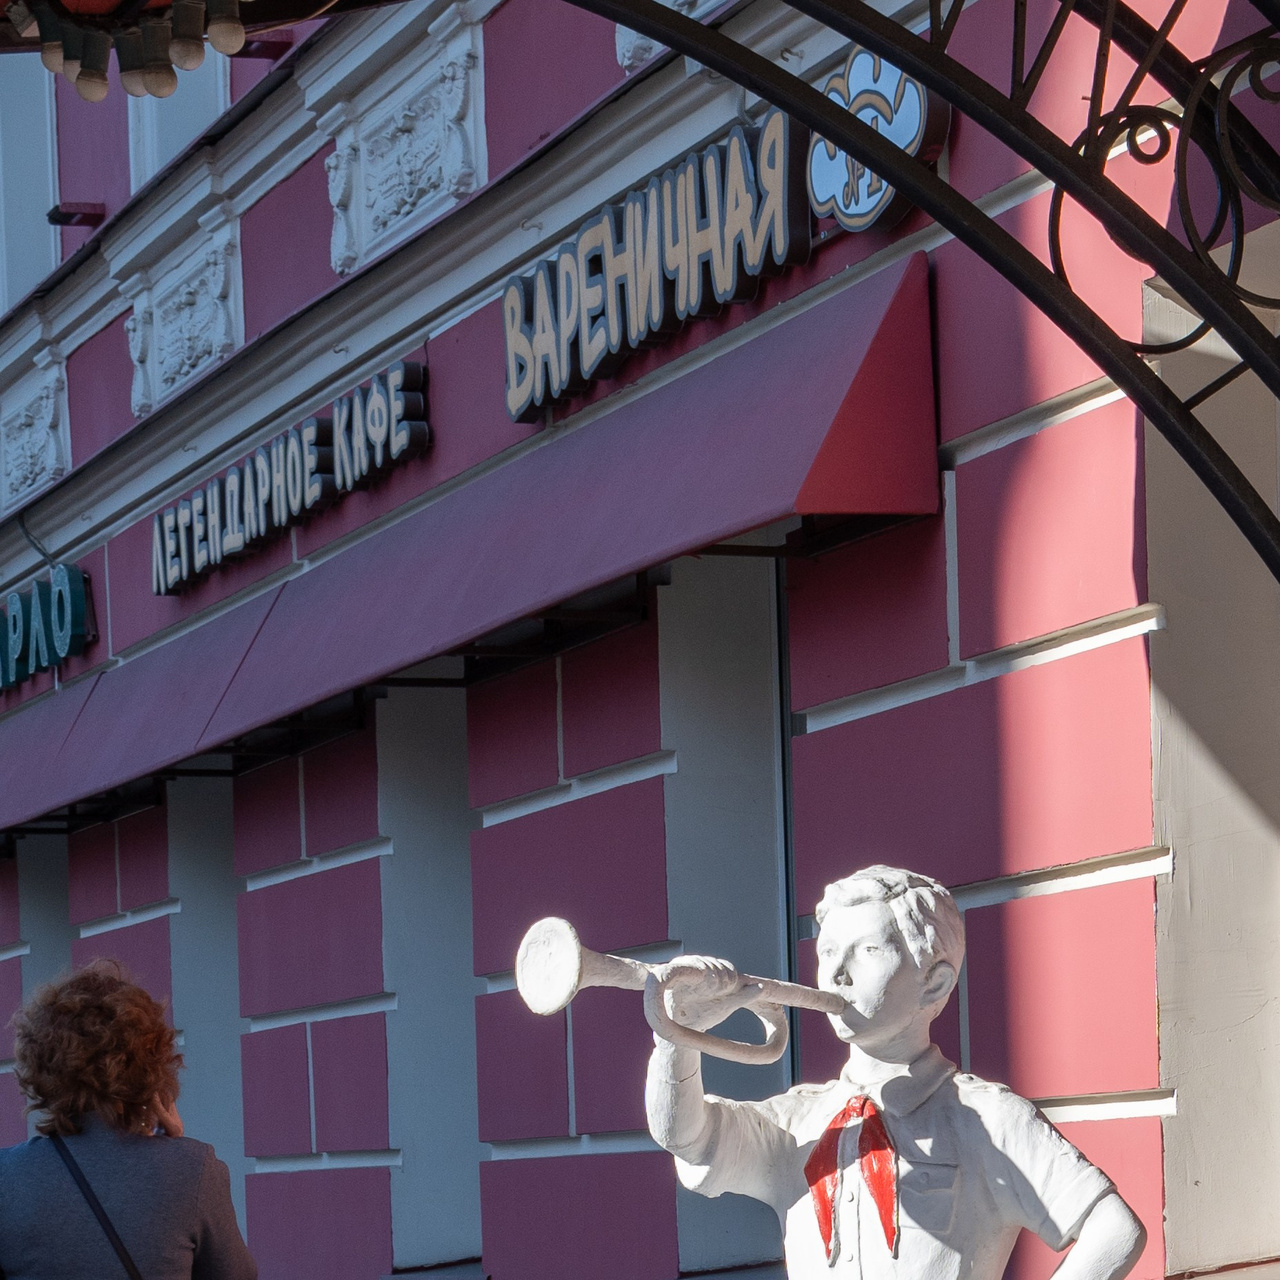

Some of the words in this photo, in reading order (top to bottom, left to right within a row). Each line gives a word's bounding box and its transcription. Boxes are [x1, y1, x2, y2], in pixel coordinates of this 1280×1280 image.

[504, 107, 789, 420] ВАРЕНИЧНАЯ
[152, 417, 323, 596] ЛЕГЕНДАРНОЕ
[333, 360, 411, 492] КАФЕ
[0, 563, 72, 688] РЛО
